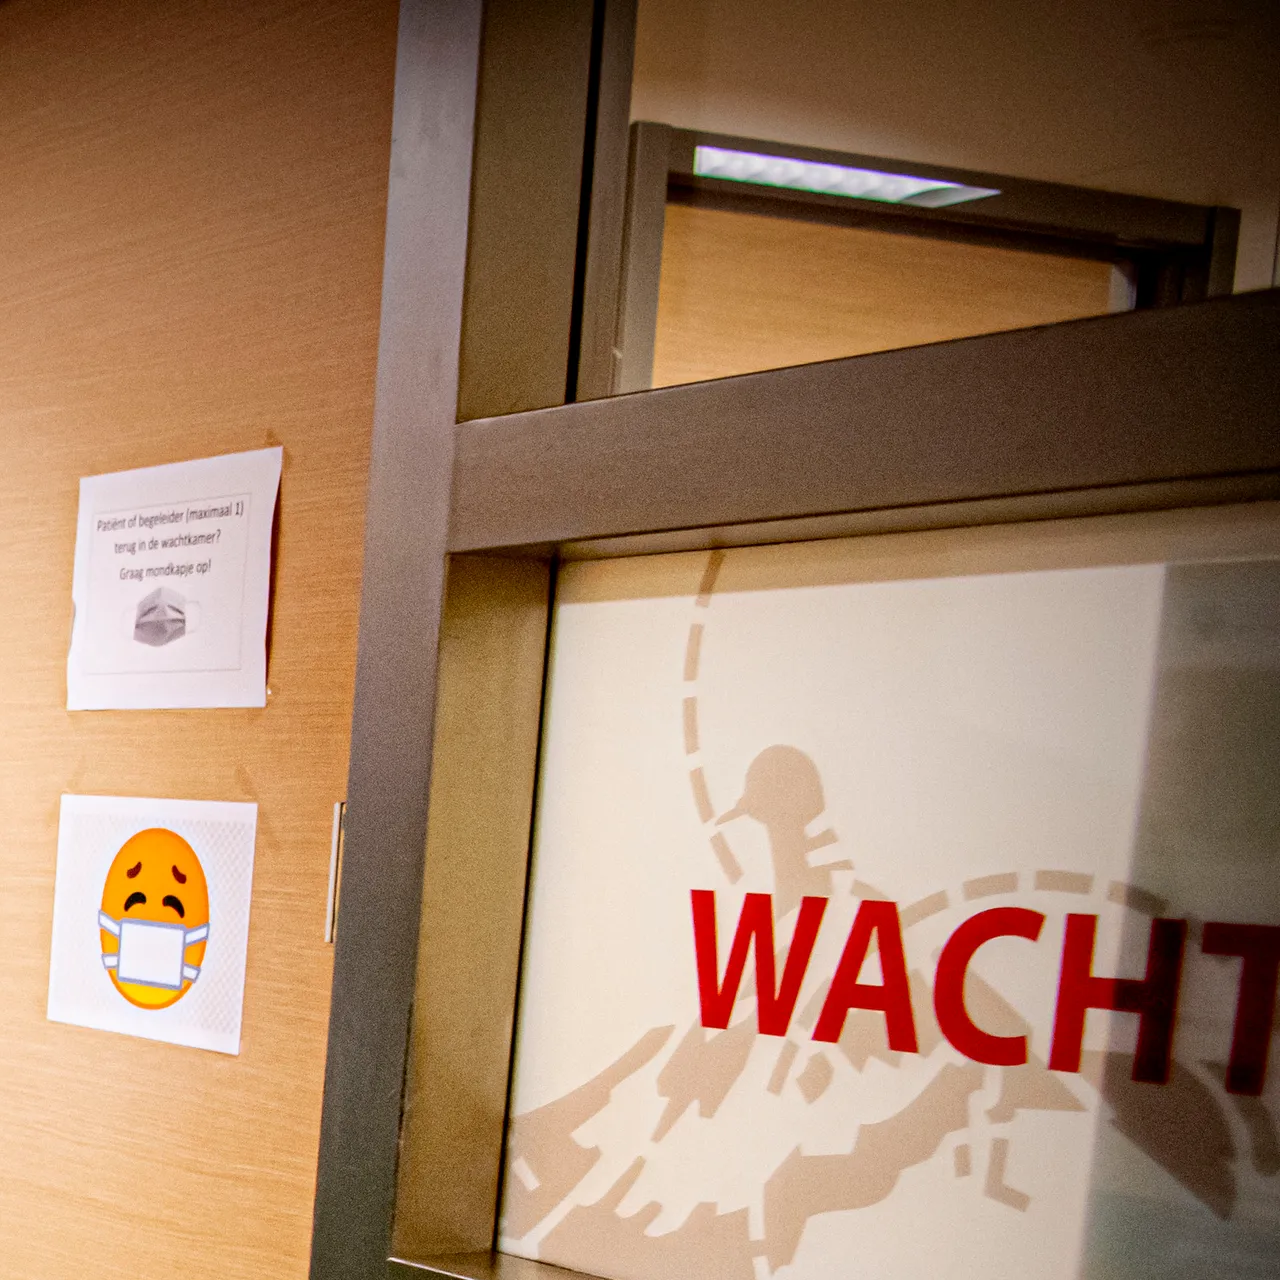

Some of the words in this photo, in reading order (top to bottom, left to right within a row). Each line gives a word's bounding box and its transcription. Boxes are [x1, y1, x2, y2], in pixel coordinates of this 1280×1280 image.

[128, 515, 137, 529] of
[138, 511, 184, 529] begeleider
[185, 503, 233, 524] (maximaal
[235, 501, 244, 519] 1)
[114, 541, 137, 555] terug
[138, 540, 146, 551] in
[148, 537, 159, 550] de
[161, 529, 221, 549] wachtkamer?
[119, 567, 144, 582] Graag
[145, 562, 194, 578] mondkapje
[196, 559, 211, 575] op!
[690, 888, 1280, 1097] WACHT
